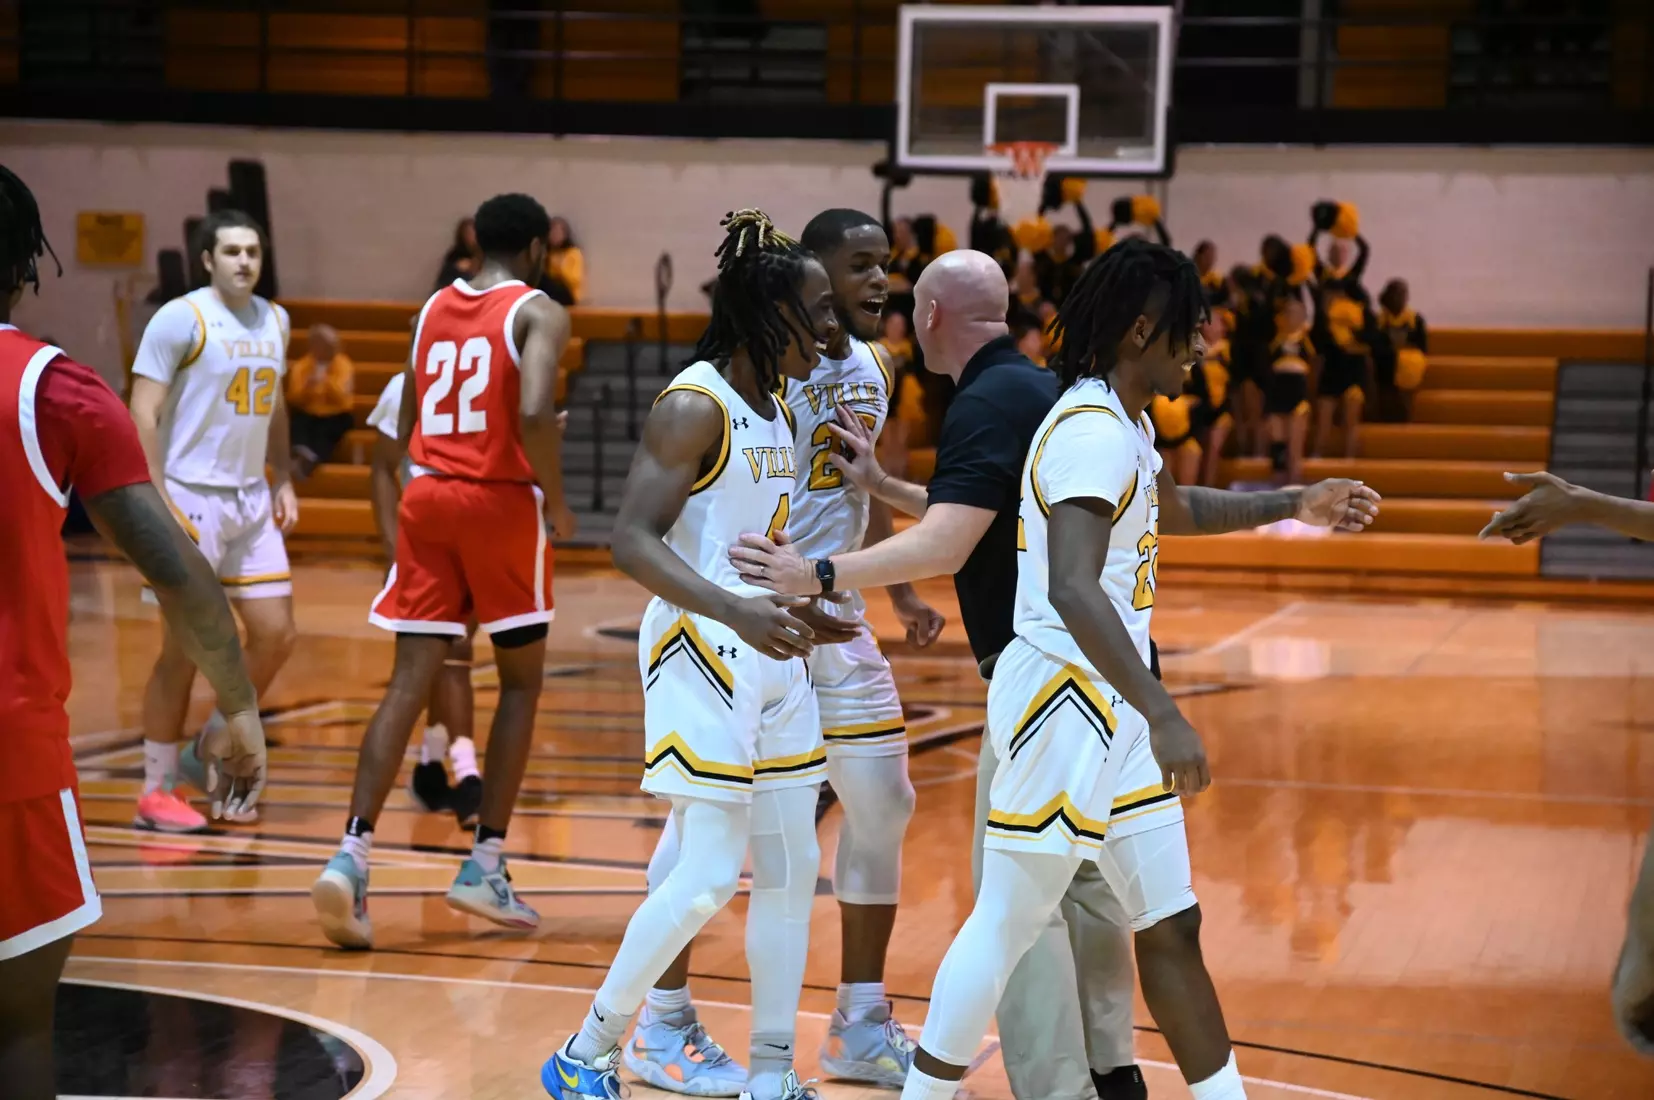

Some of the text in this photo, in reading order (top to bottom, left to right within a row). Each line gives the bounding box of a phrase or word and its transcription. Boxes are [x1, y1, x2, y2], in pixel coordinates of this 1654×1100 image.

[225, 366, 277, 415] 42
[421, 336, 492, 436] 22
[803, 381, 882, 416] VILLE
